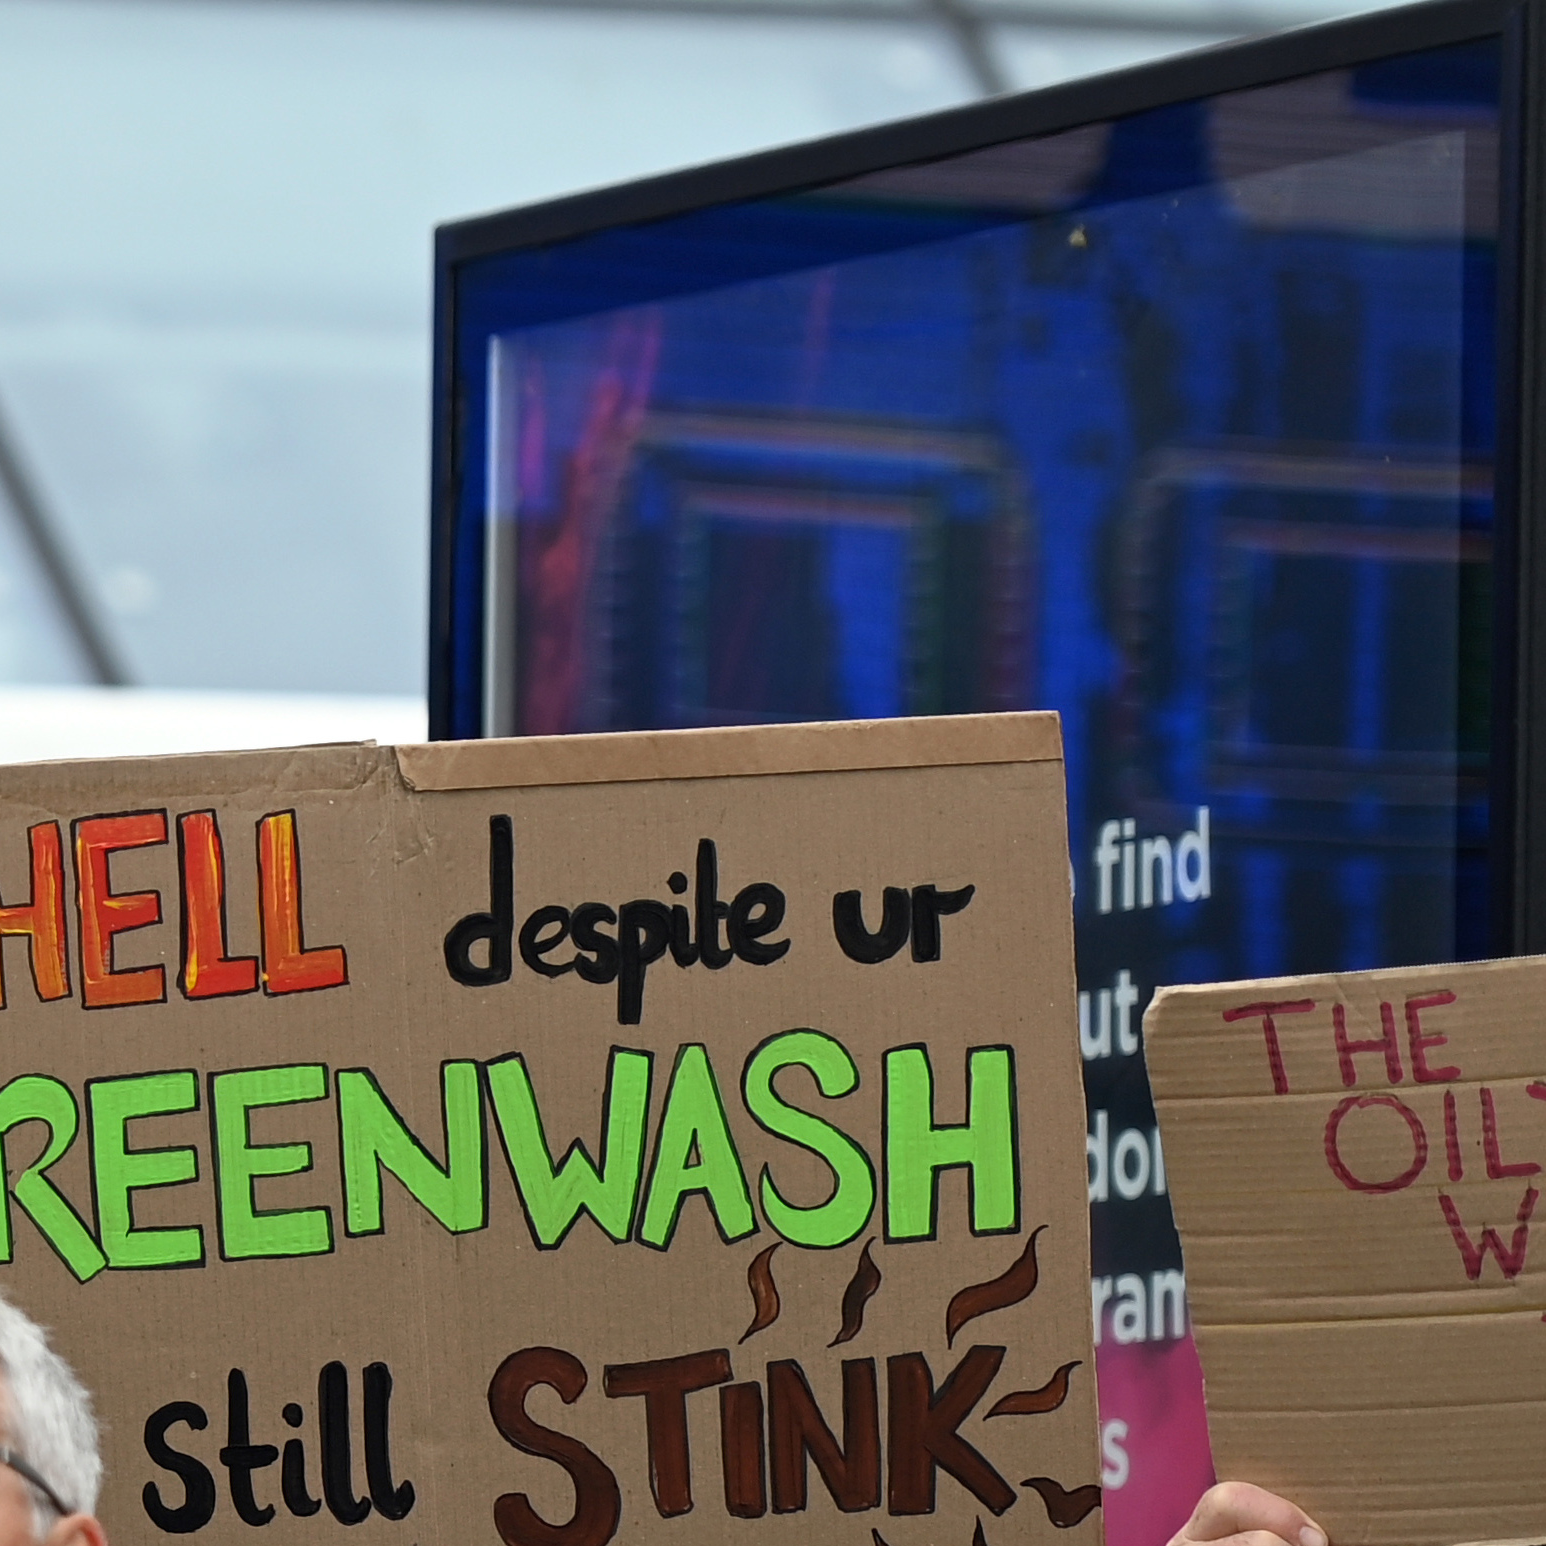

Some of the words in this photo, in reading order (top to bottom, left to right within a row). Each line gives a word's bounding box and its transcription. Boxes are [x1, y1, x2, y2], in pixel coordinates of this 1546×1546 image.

[1096, 805, 1211, 915] find
[443, 813, 790, 1025] despite
[832, 883, 975, 963] ur
[1222, 990, 1462, 1095] THE
[1325, 1082, 1546, 1193] OIL
